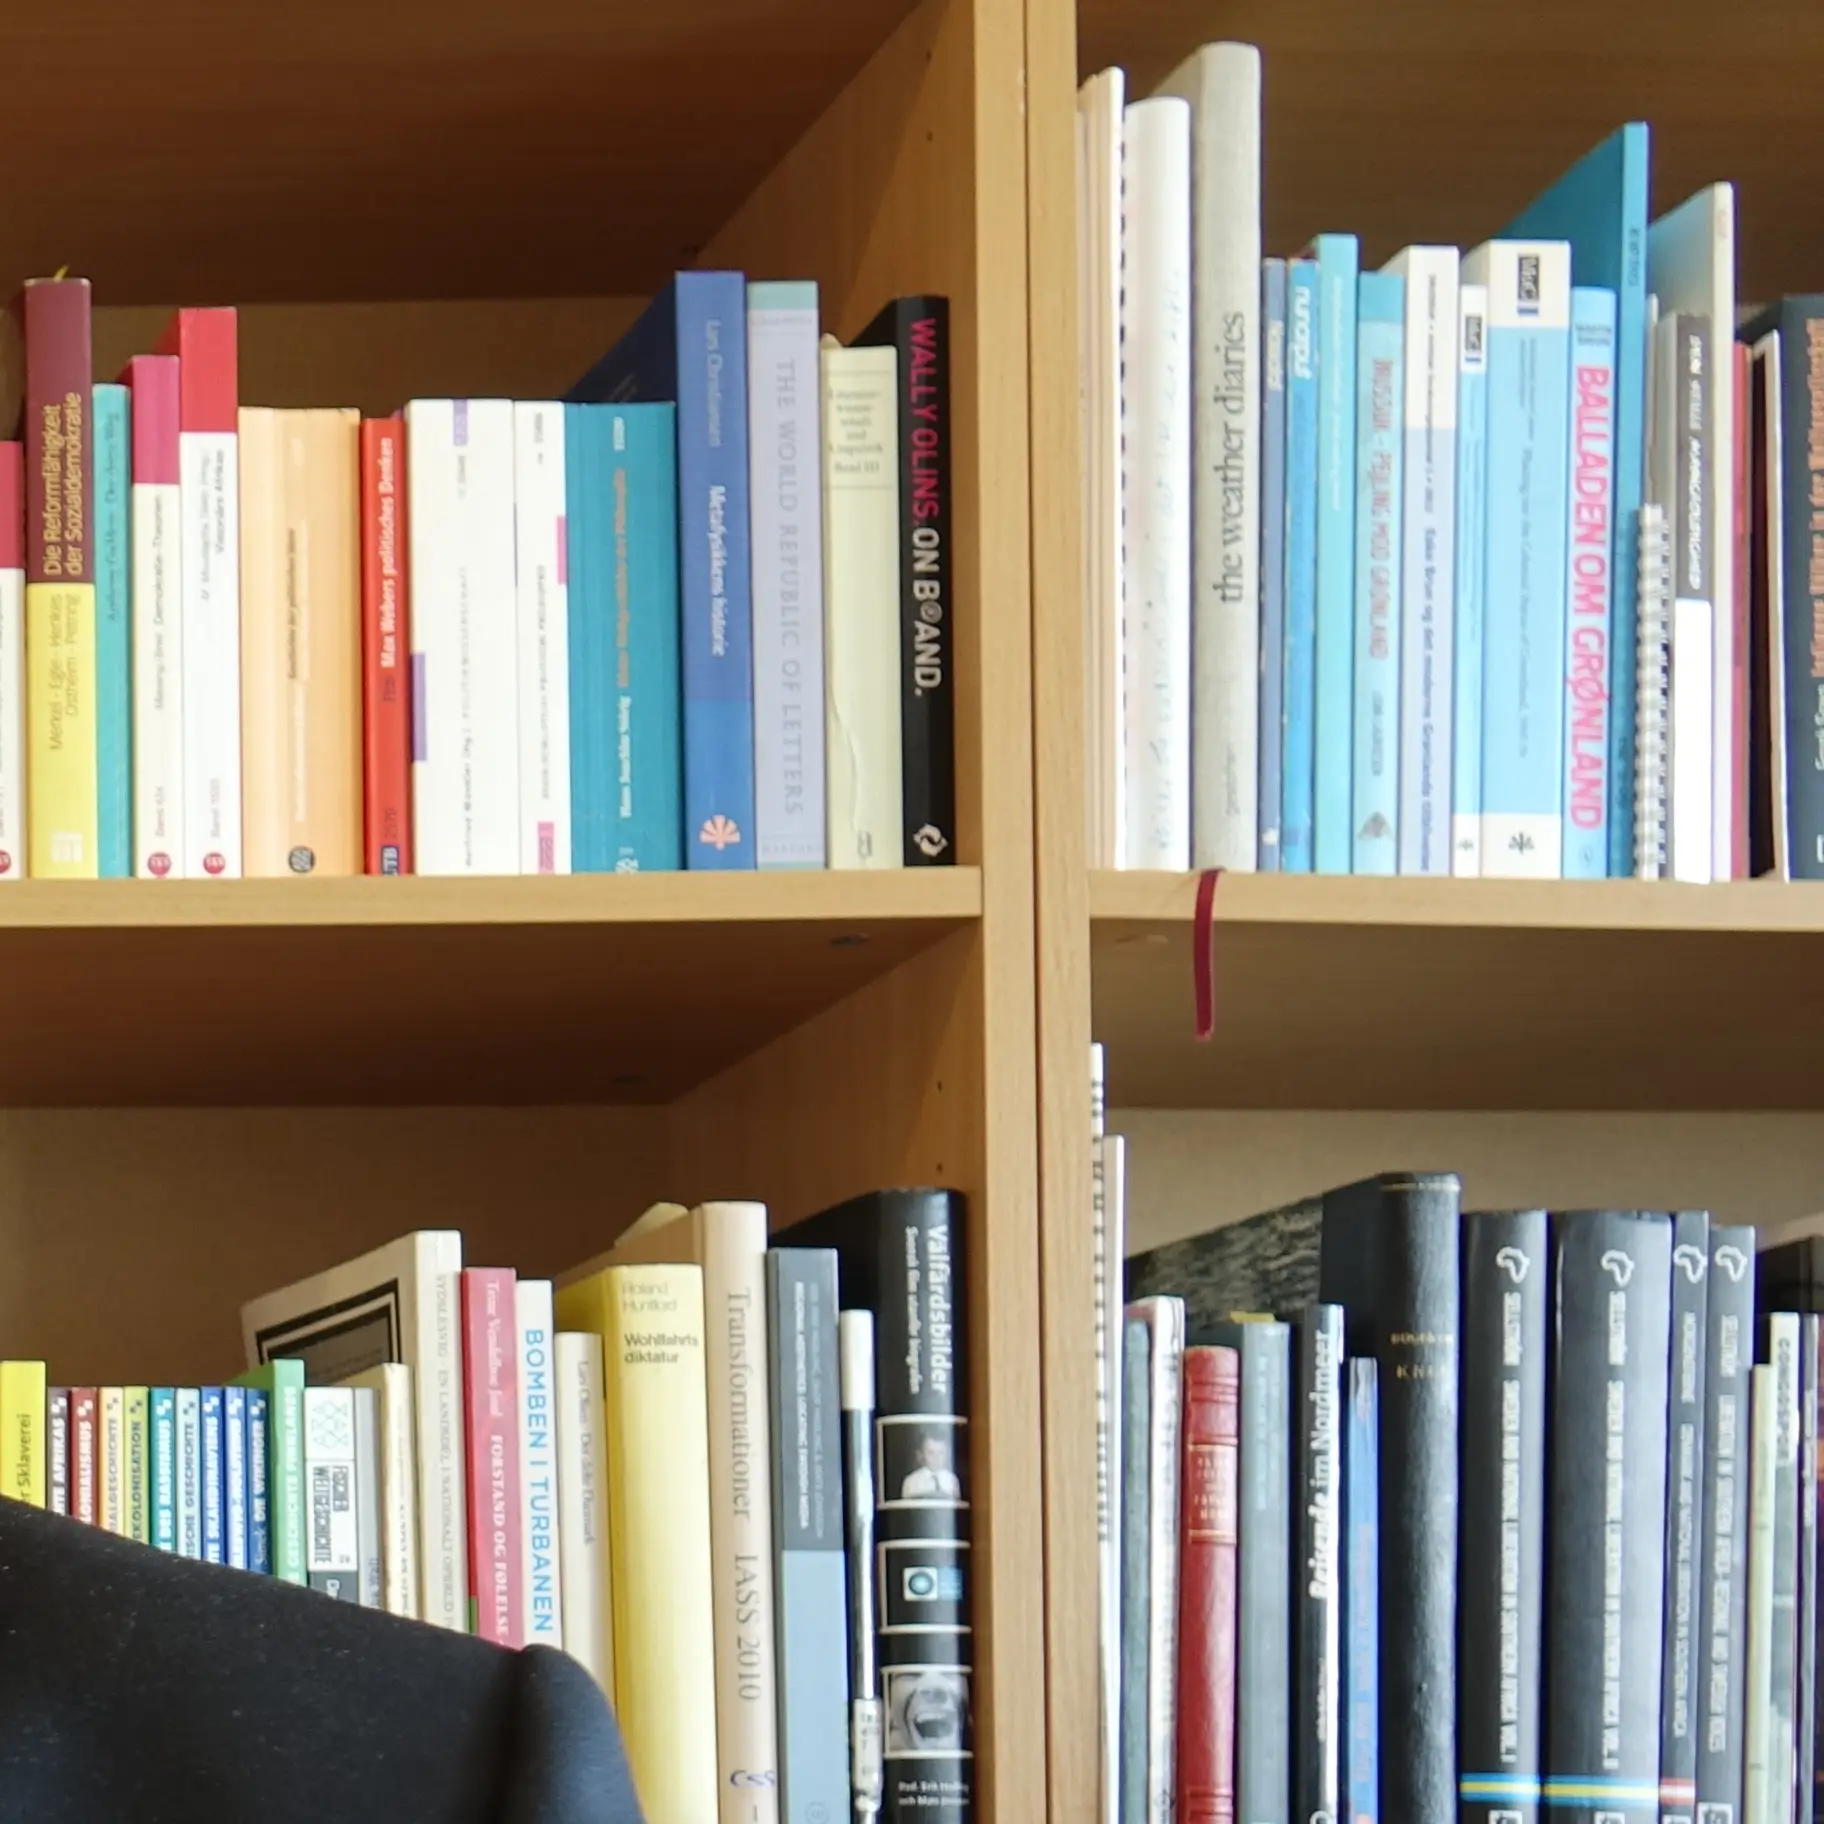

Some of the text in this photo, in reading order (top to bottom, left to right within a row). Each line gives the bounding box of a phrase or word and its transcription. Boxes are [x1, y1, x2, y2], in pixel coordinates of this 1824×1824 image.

[776, 362, 797, 407] THE
[911, 319, 937, 422] WALLY
[42, 405, 63, 575] Die Reformfähigkeit
[62, 393, 83, 575] der Sozialdemokratie
[777, 418, 799, 510] WORLD
[1213, 312, 1246, 602] the weather diaries
[1575, 366, 1609, 544] BALLADEN
[779, 525, 801, 645] REPUBLIC
[782, 704, 804, 814] LETTERS
[1570, 627, 1607, 828] GRØNLAND
[928, 1226, 951, 1392] Välfärdsbilder
[15, 1414, 33, 1487] Sklaverei
[526, 1329, 547, 1448] BOMBEN
[727, 1291, 754, 1517] Transformationer
[1310, 1330, 1332, 1451] Nordmeer
[530, 1477, 552, 1631] TURBANEN
[1310, 1493, 1331, 1599] Reisende
[734, 1555, 761, 1700] IASS 2010
